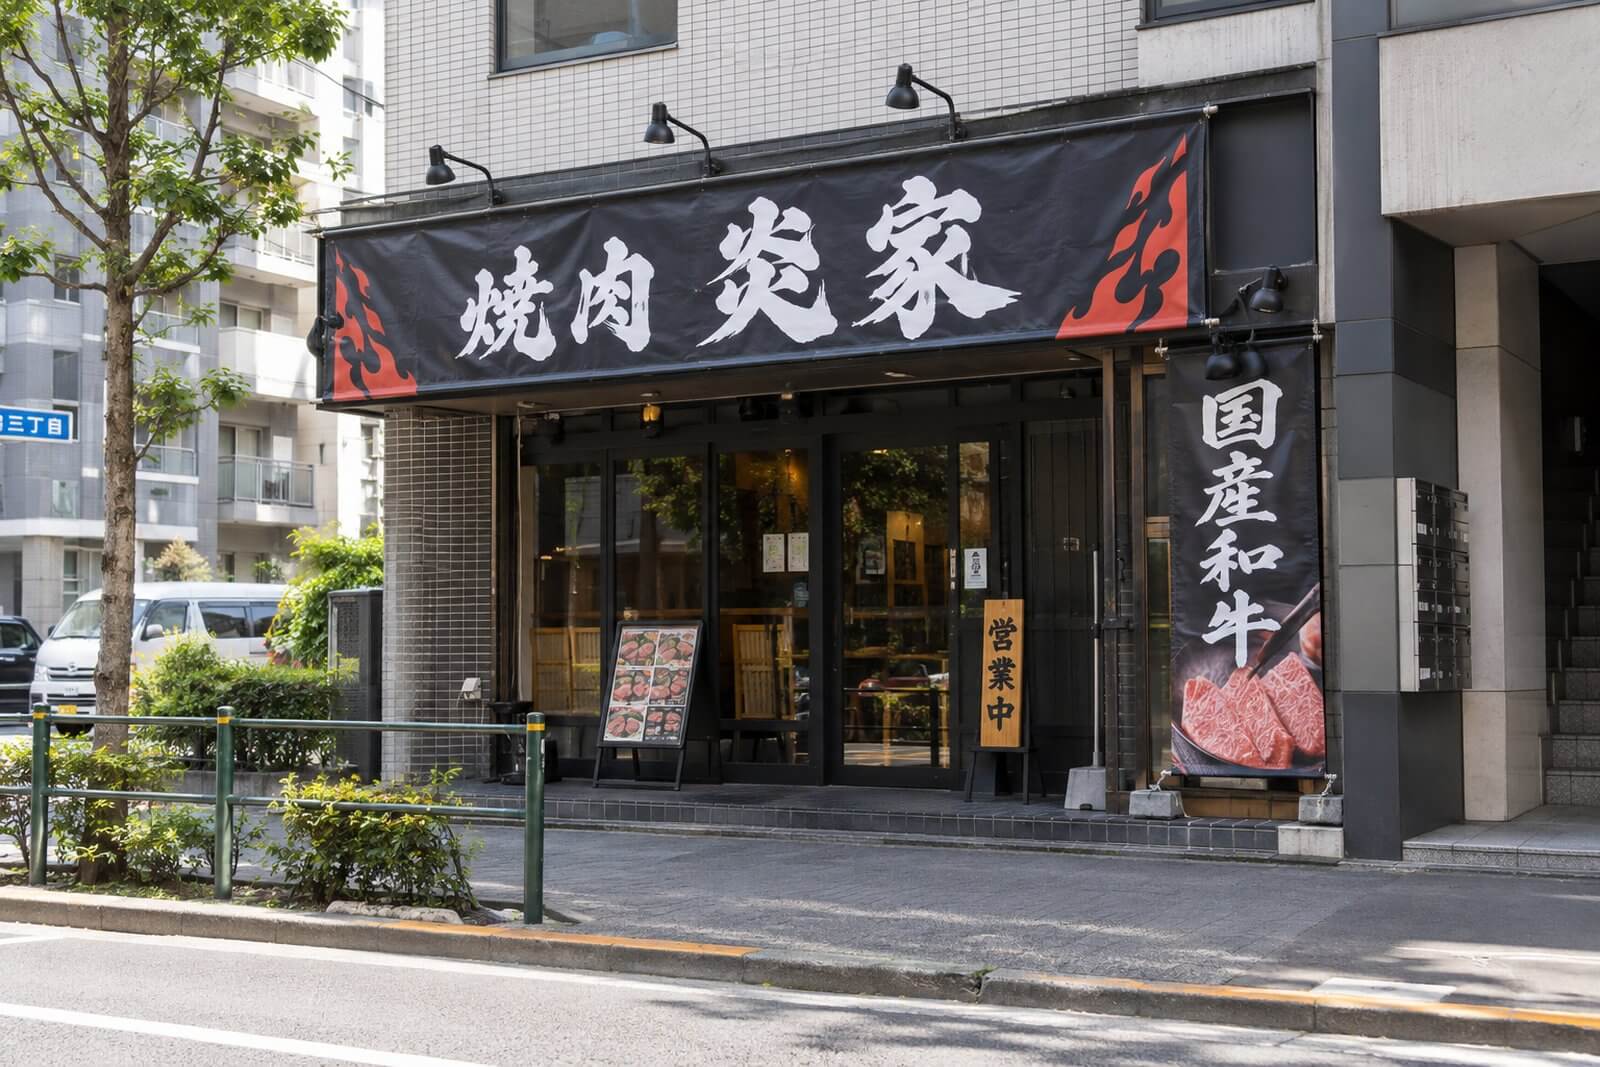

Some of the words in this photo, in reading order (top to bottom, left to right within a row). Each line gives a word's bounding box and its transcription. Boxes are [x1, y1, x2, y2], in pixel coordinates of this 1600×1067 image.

[455, 235, 655, 362] 焼肉
[696, 175, 1022, 348] 炎家
[0, 414, 62, 436] 三丁目
[1194, 378, 1283, 669] 国産和牛
[986, 616, 1018, 732] 営業中
